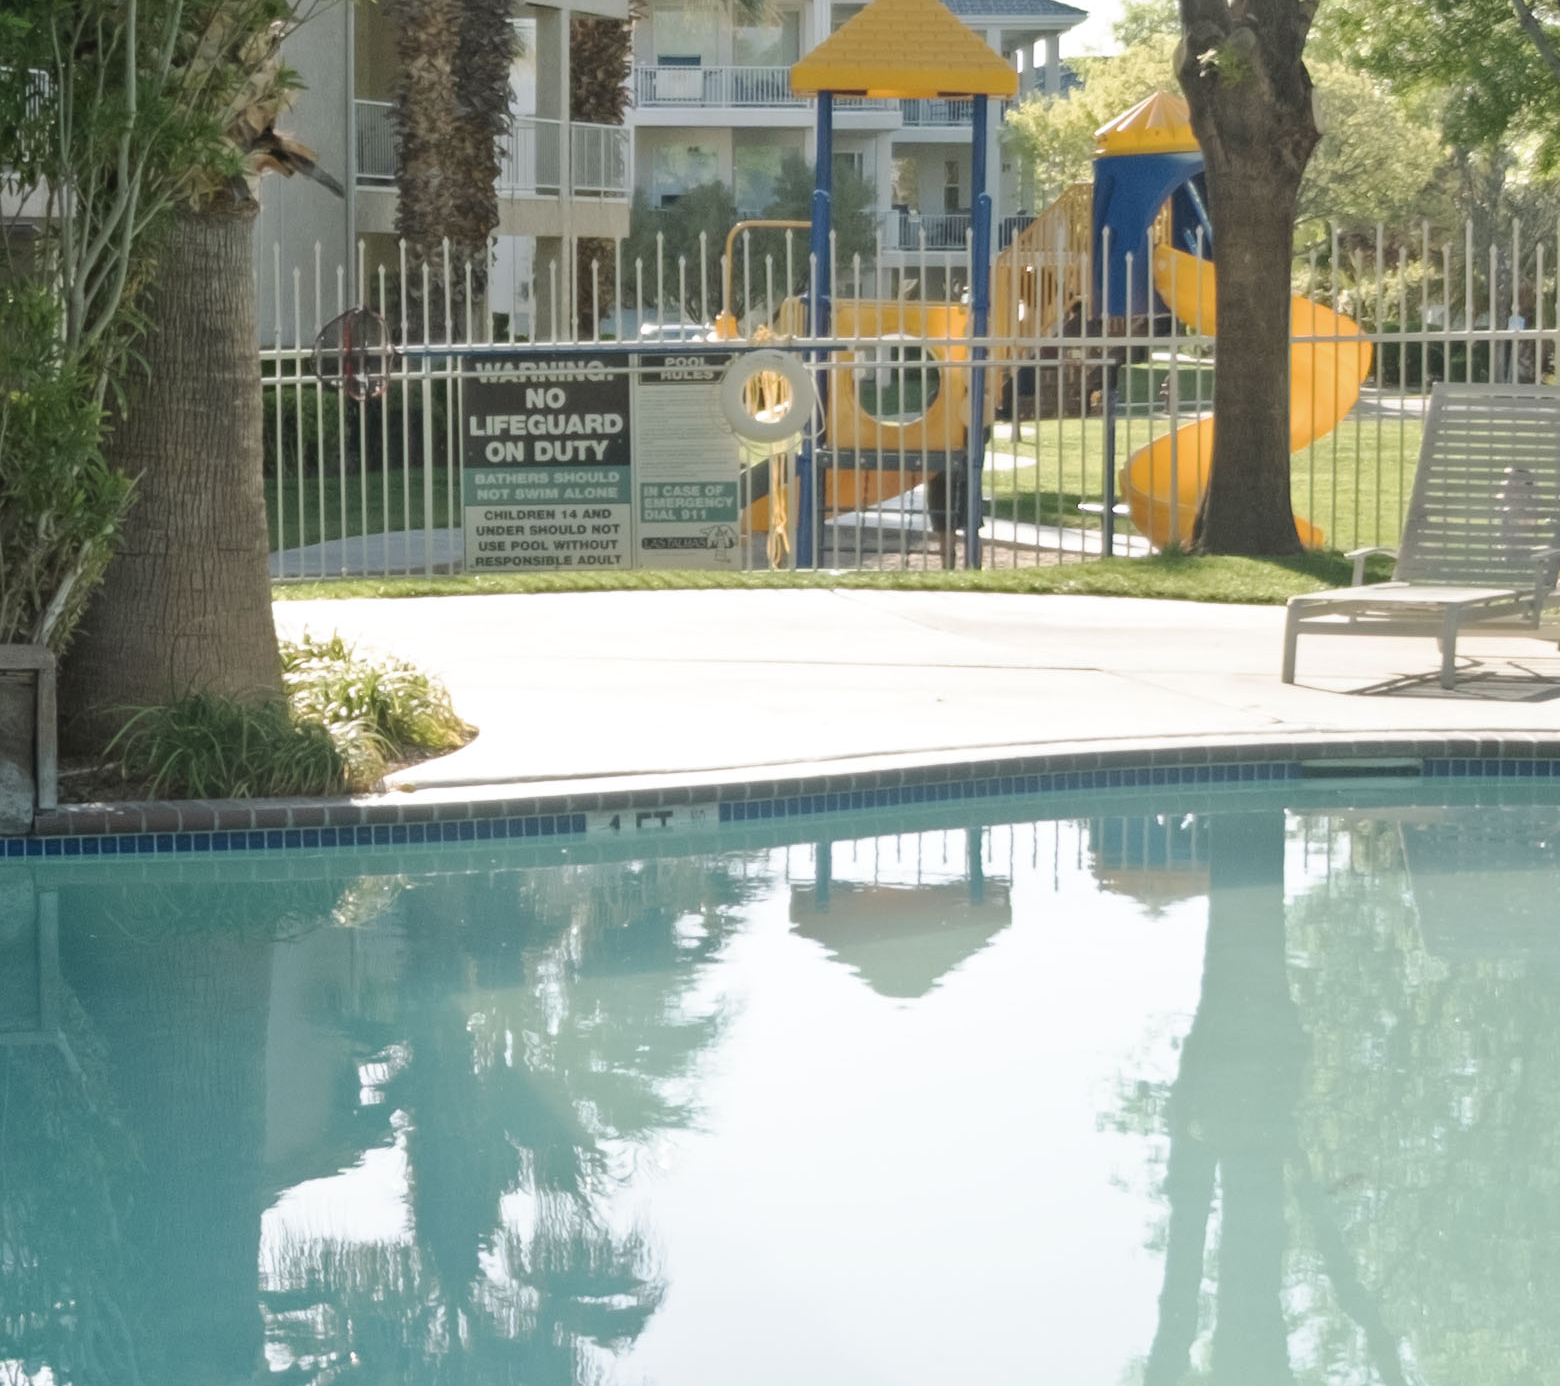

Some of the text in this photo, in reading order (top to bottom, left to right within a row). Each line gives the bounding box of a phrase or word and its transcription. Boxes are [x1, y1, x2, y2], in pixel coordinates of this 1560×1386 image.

[664, 357, 710, 367] POOL
[475, 361, 614, 383] WARNING:
[525, 387, 566, 409] NO
[469, 413, 623, 437] LIFEGUARD
[485, 439, 610, 463] ON DUTY
[474, 471, 620, 485] BATHERS SHOULD
[476, 487, 618, 501] NOT SWIM ALONE
[643, 485, 724, 497] IN CASE OF
[644, 497, 734, 509] EMERGENCY
[484, 509, 612, 521] CHILDREN 14 AND
[644, 509, 707, 521] DIAL 911
[476, 523, 621, 537] UNDER SHOULD NOT
[478, 539, 619, 552] USE POOL WITHOUT
[475, 554, 624, 567] RESPONSIBLE ADULT
